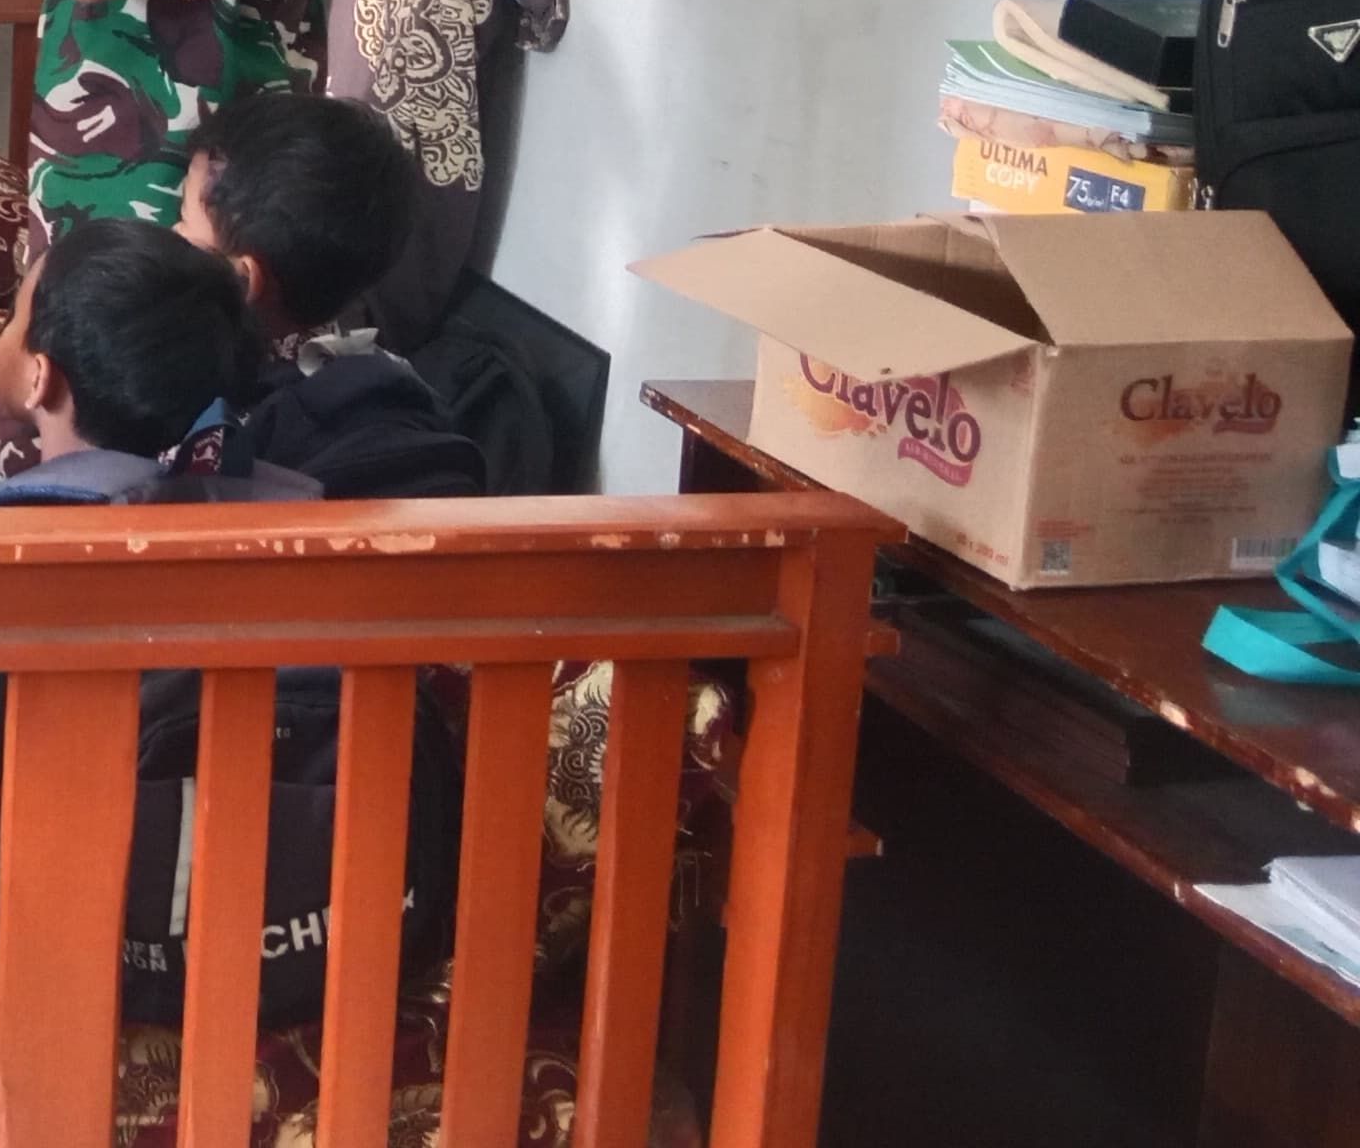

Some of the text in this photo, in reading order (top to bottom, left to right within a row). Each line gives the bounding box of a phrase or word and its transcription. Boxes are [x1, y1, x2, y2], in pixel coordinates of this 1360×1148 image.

[980, 139, 1048, 177] ULTIMA
[985, 163, 1041, 194] COPY
[1066, 175, 1091, 202] 75
[1110, 184, 1129, 206] F4
[1120, 372, 1282, 422] Clavelo
